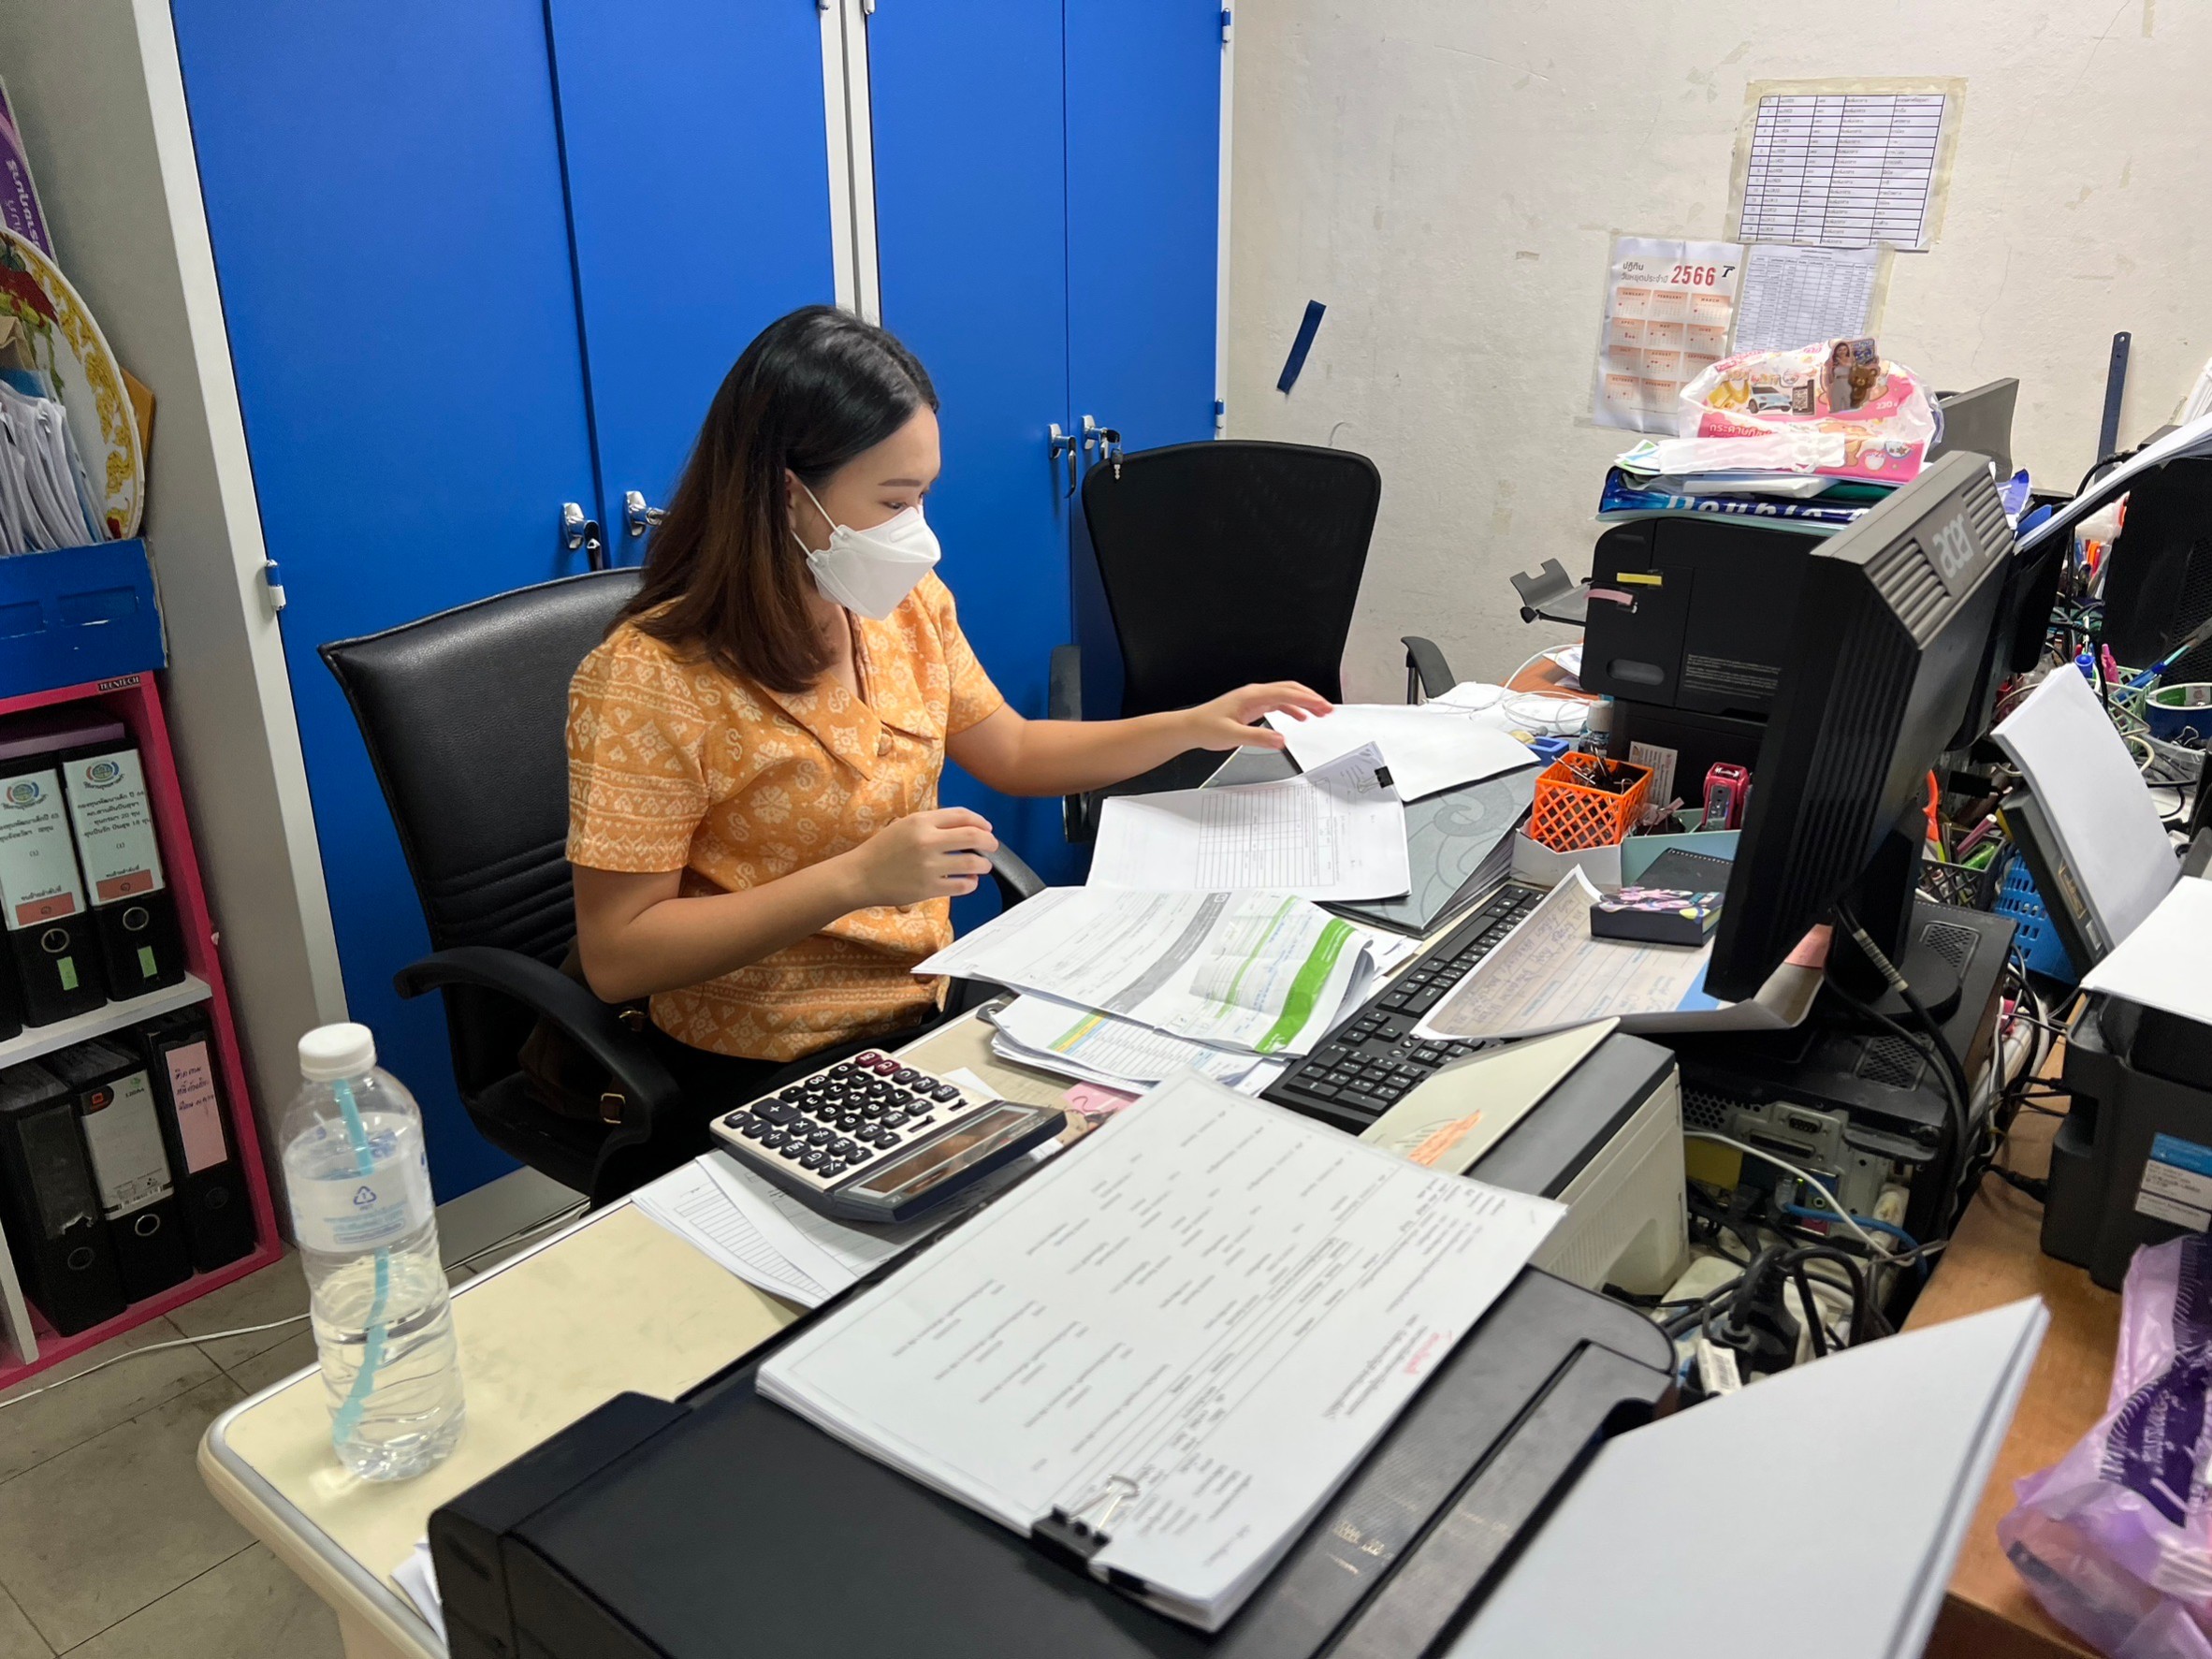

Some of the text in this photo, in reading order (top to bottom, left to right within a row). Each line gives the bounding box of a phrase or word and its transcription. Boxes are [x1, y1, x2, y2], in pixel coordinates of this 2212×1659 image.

[1623, 261, 1644, 272] ปฏิทิน
[1670, 265, 1717, 286] 2566
[1932, 514, 1974, 578] acer
[860, 1051, 876, 1062] ON
[878, 1061, 893, 1070] CE
[809, 1076, 825, 1084] 00
[830, 1084, 842, 1093] 2
[786, 1141, 804, 1152] MU
[808, 1152, 822, 1162] GT
